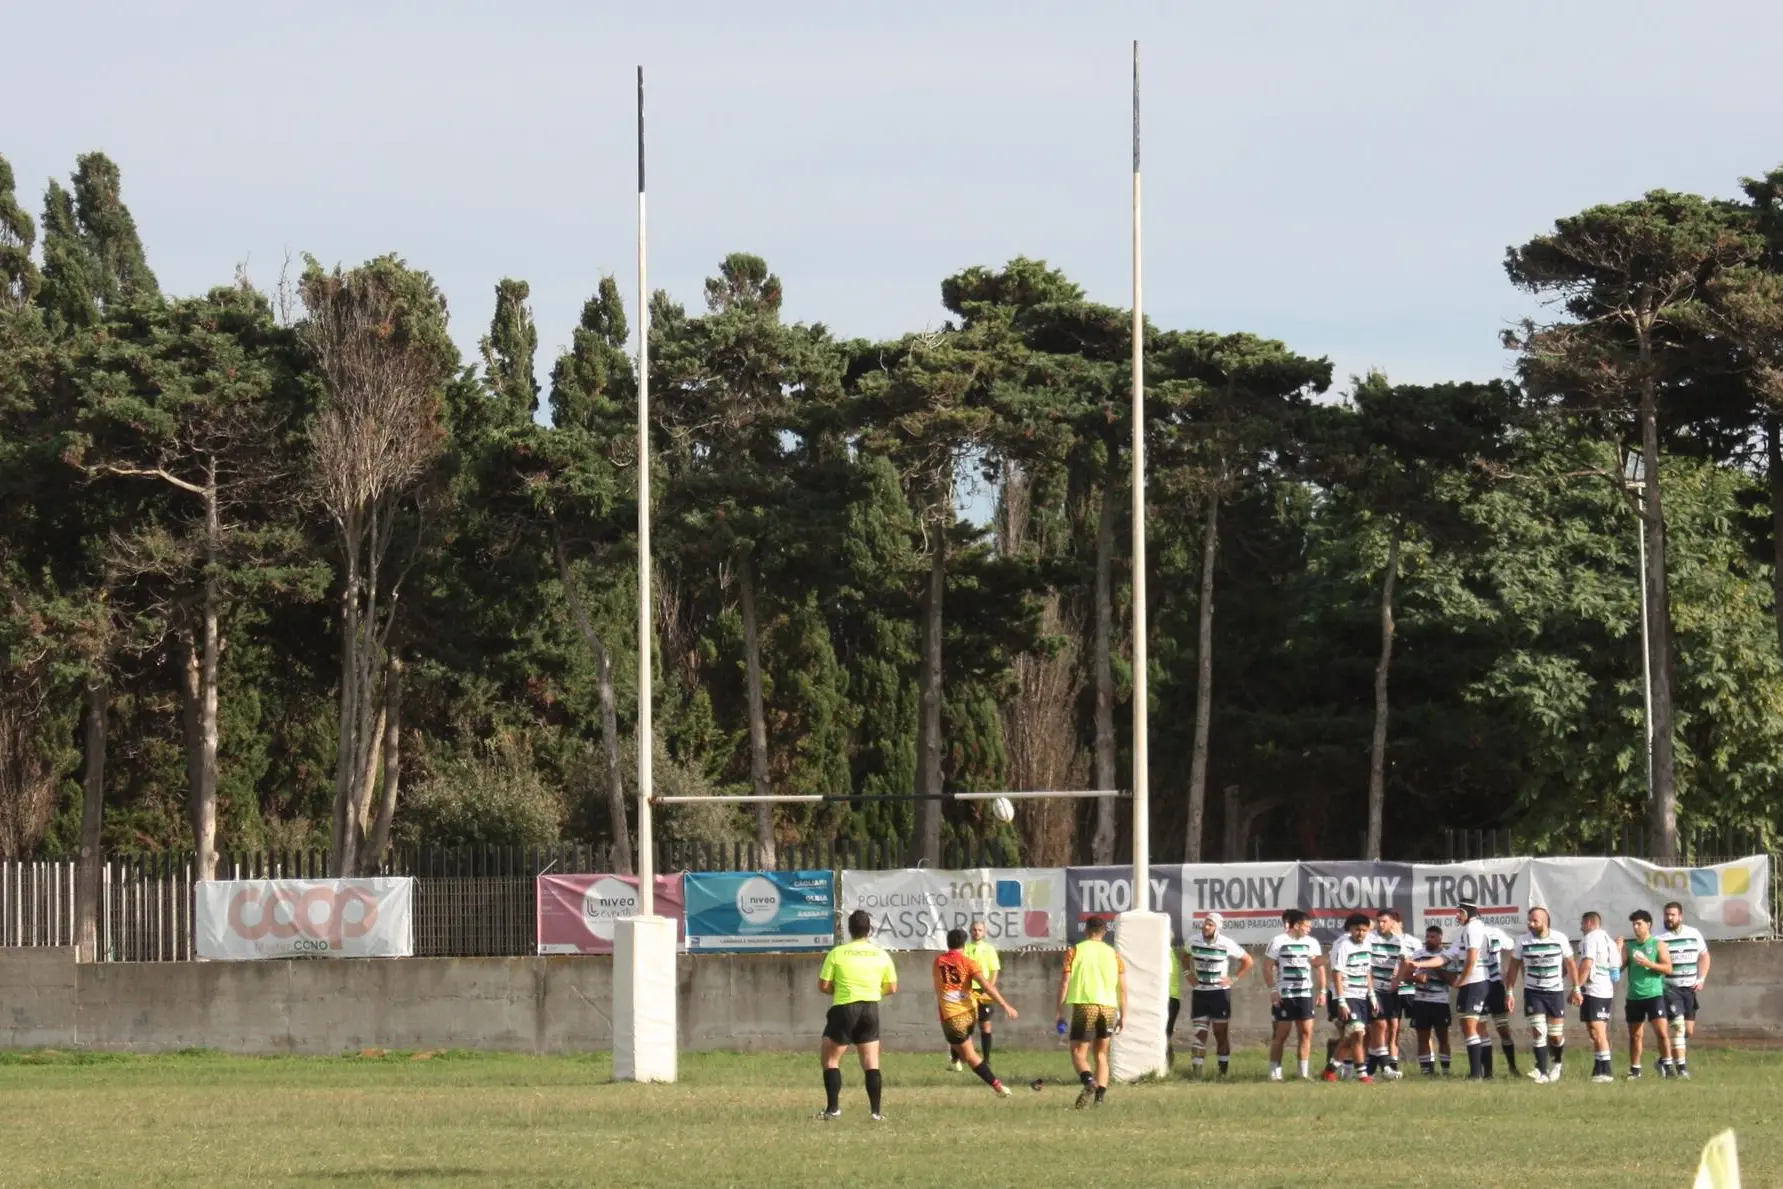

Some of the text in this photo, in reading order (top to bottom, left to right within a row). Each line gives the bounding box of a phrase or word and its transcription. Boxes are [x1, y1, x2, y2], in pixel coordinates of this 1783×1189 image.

[600, 897, 635, 907] nivea
[750, 896, 776, 904] nivea
[858, 893, 948, 908] POLICLINICO
[1078, 879, 1169, 912] TROY
[1193, 877, 1285, 909] TRONY
[1308, 875, 1400, 909] TRONY
[1425, 872, 1519, 907] TRONY
[228, 886, 378, 949] coop
[1223, 919, 1246, 929] SONO
[1248, 918, 1284, 929] PARAGON
